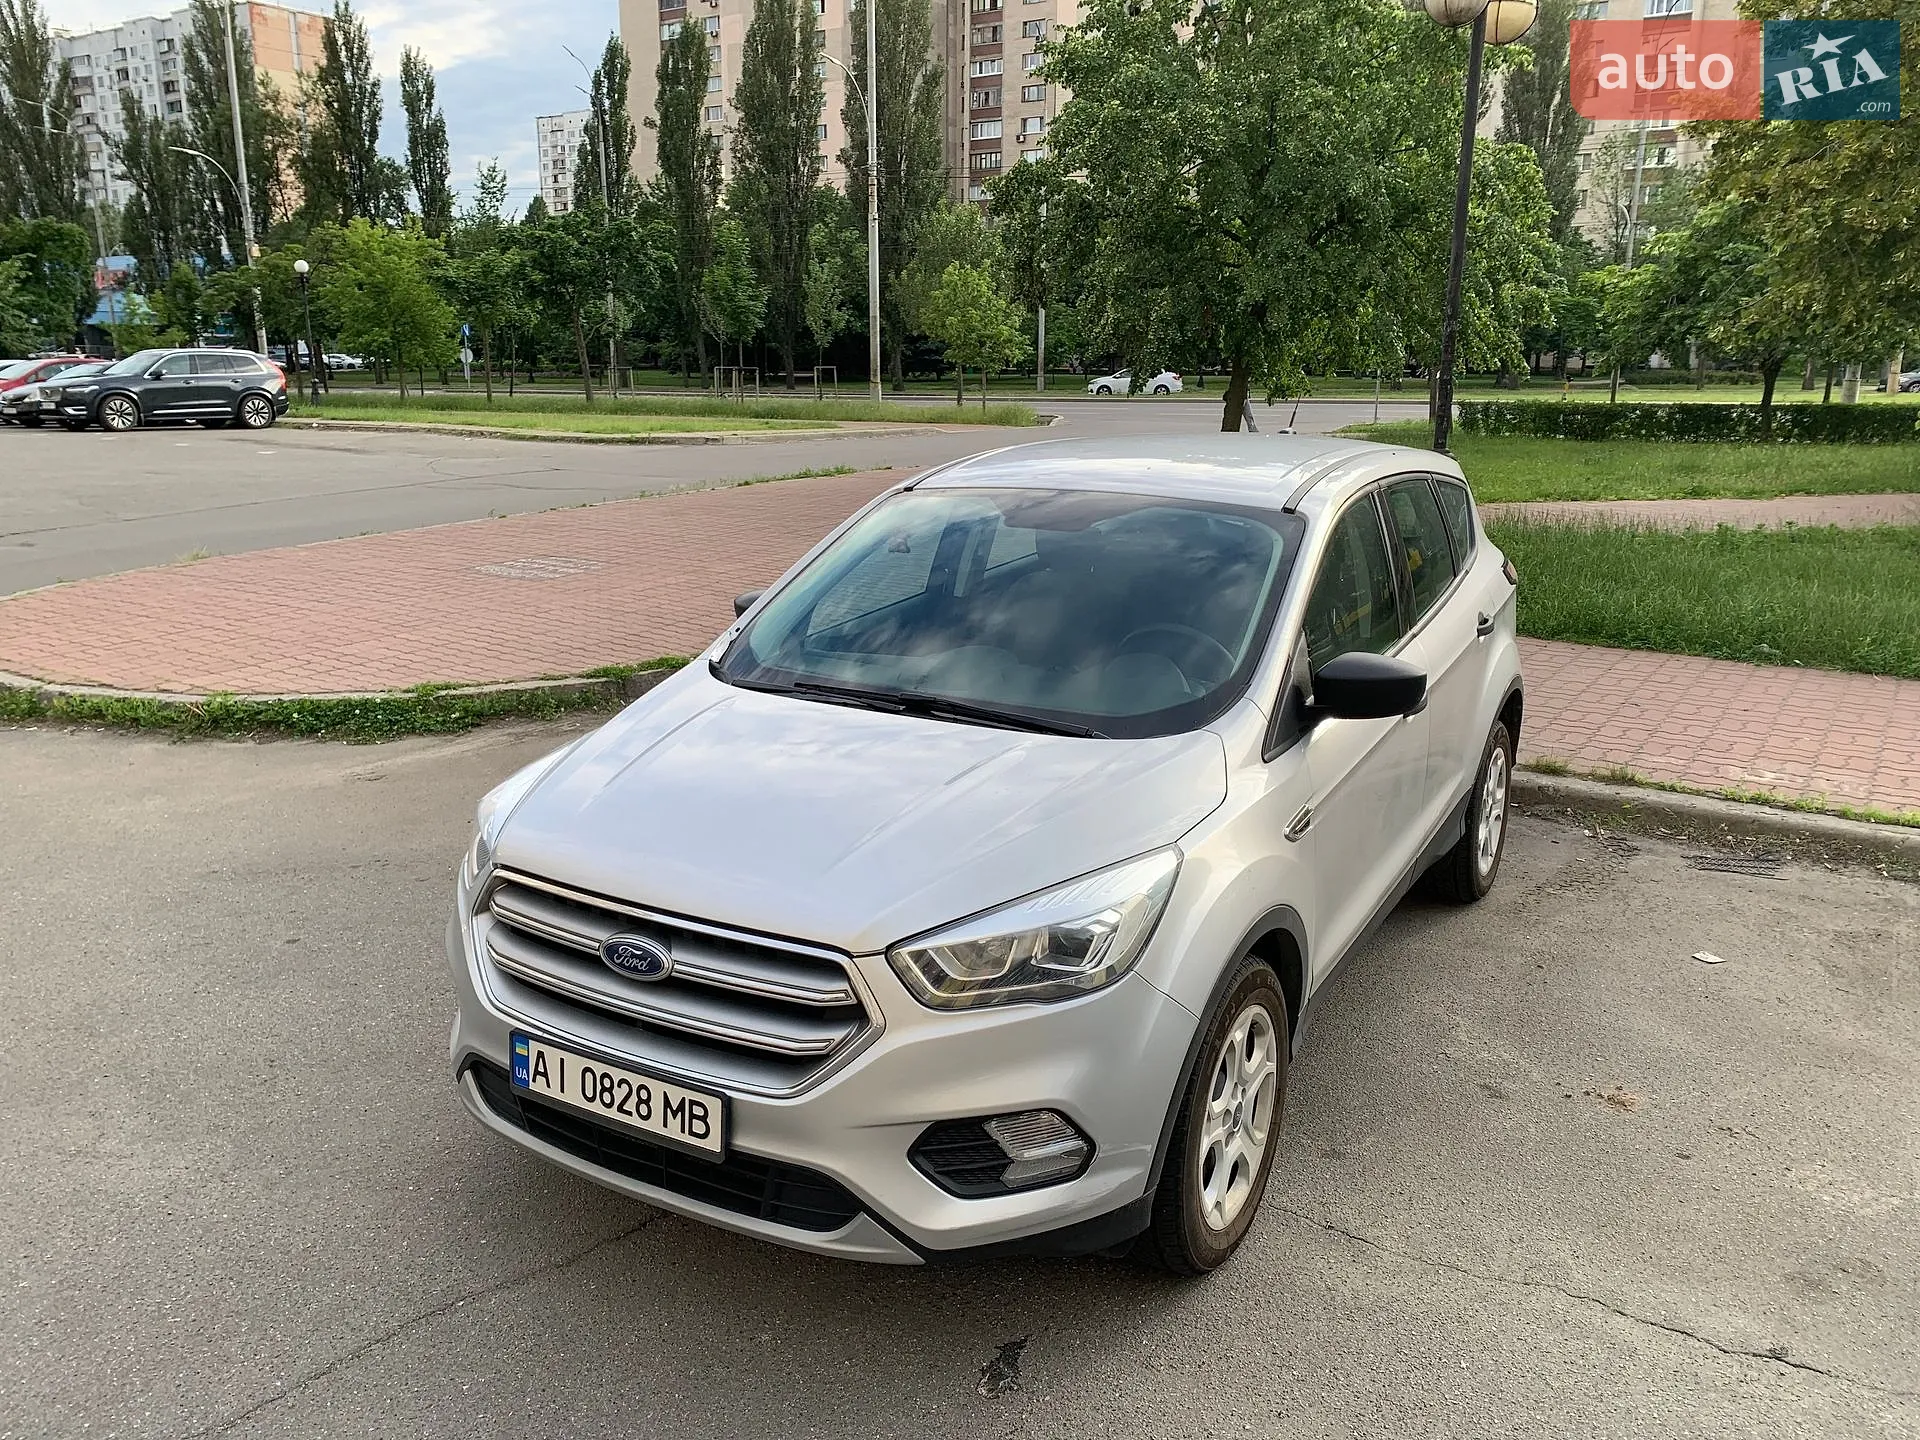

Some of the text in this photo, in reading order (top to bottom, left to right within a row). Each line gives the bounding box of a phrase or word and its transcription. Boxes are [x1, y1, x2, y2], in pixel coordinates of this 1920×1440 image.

[614, 945, 651, 971] Ford
[515, 1066, 529, 1081] UA
[531, 1049, 711, 1140] AI 0828 MB
